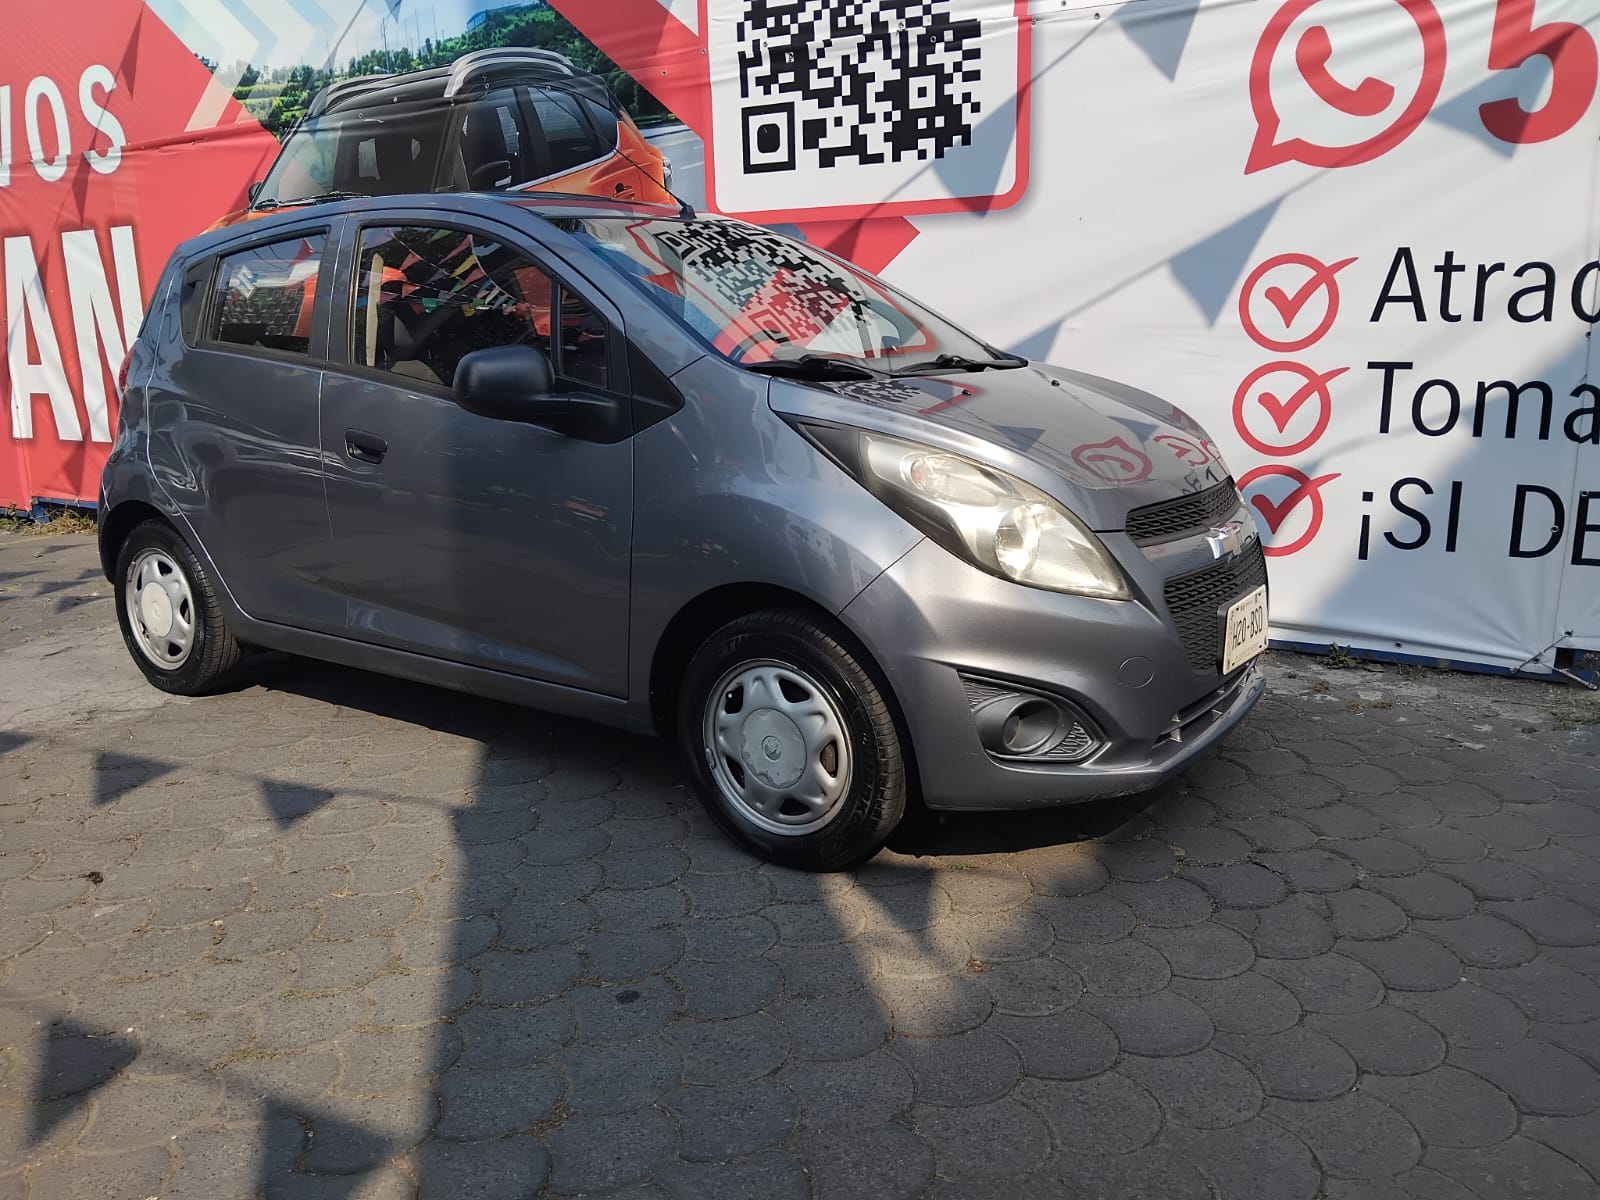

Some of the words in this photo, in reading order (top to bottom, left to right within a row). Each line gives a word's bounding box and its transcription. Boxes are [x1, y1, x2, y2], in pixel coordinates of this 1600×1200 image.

[1479, 0, 1598, 144] 5
[1367, 361, 1600, 445] Toma
[1358, 477, 1462, 560] ¡SI
[1508, 484, 1600, 567] DE
